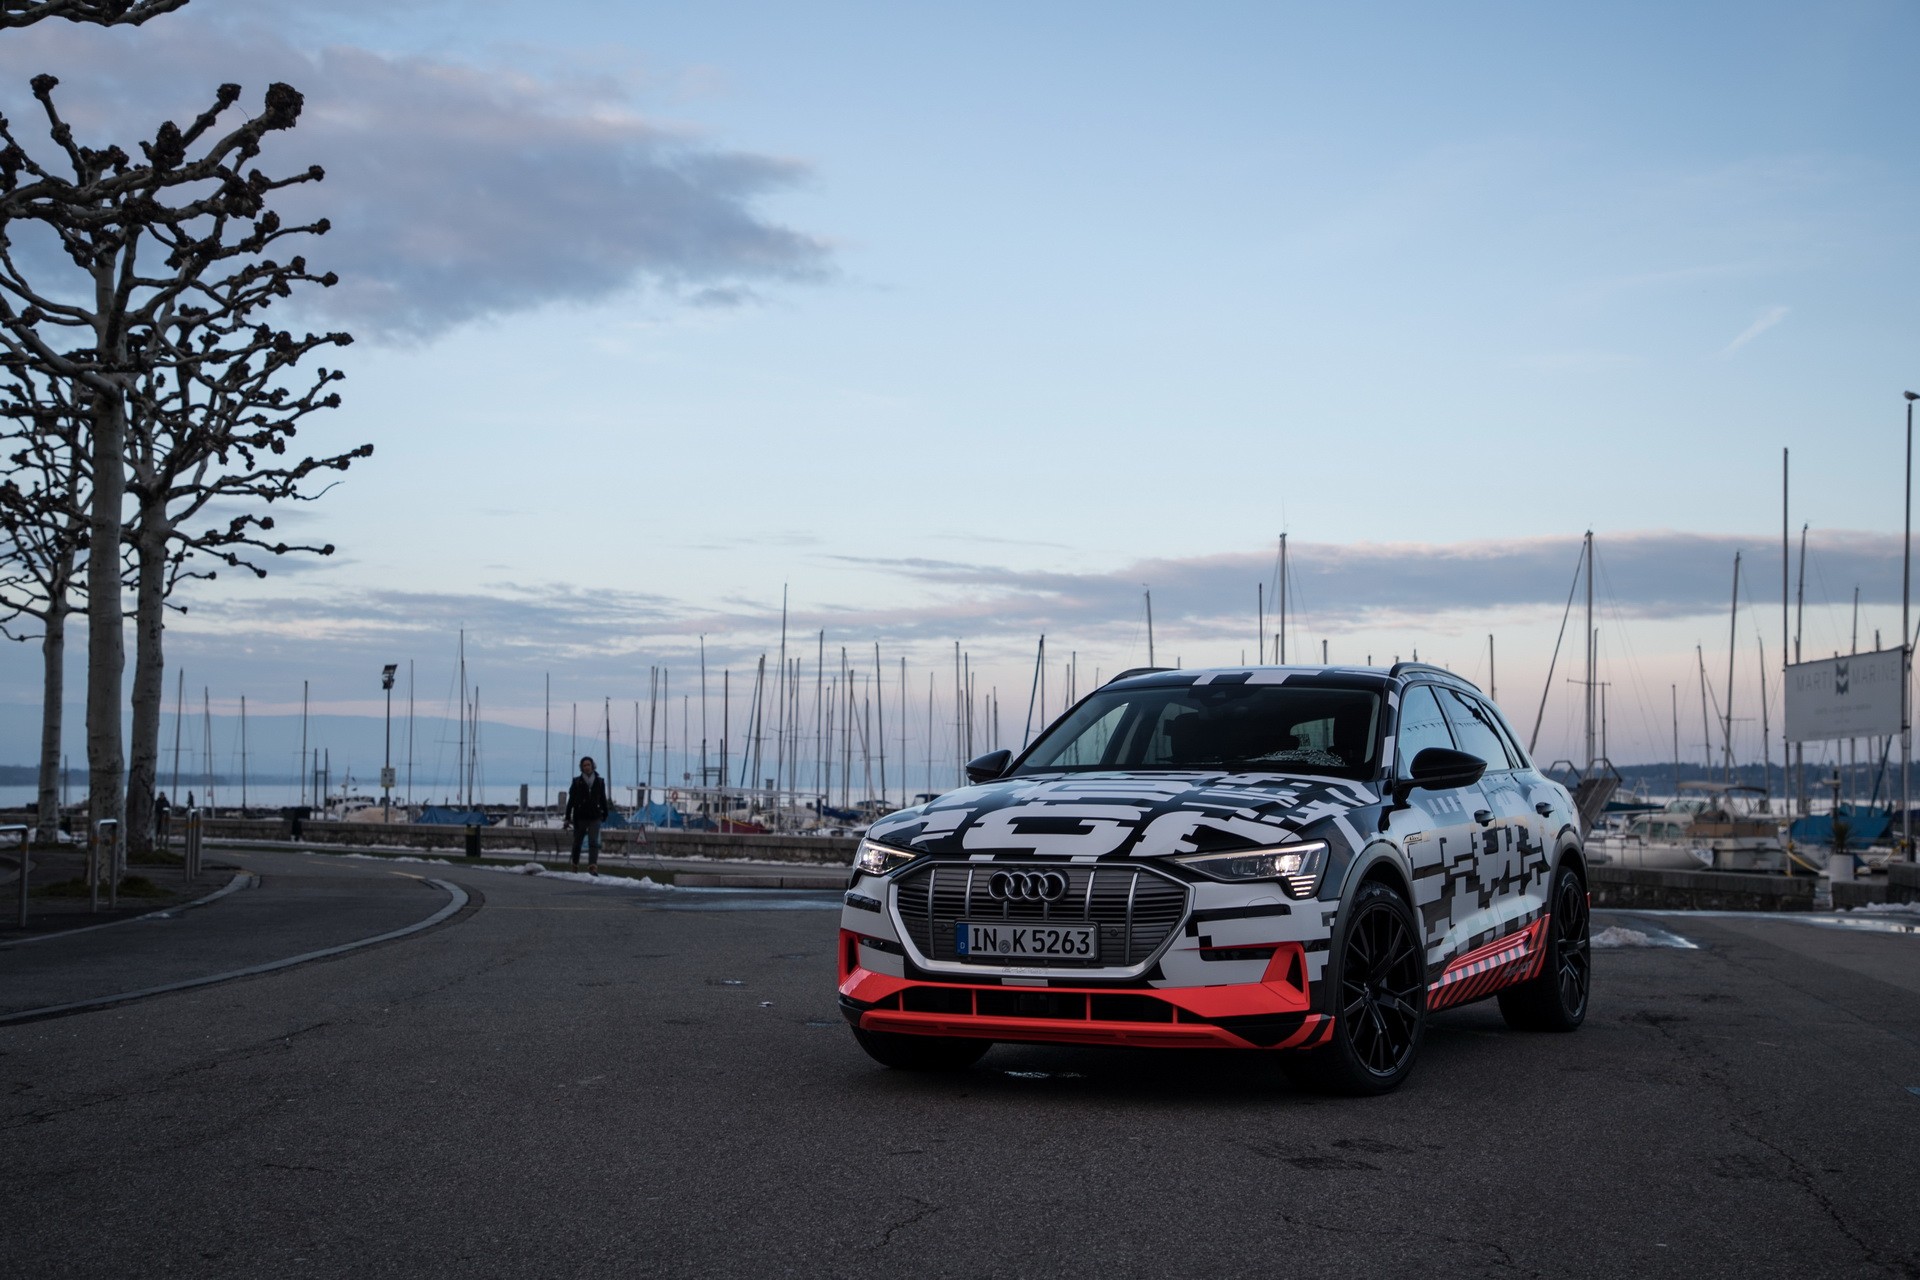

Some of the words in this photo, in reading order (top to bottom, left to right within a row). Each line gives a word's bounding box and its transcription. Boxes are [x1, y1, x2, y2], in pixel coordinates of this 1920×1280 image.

[1796, 671, 1832, 692] MARTI
[1852, 660, 1897, 685] MARINE
[971, 927, 997, 952] IN
[1032, 930, 1090, 955] 5263
